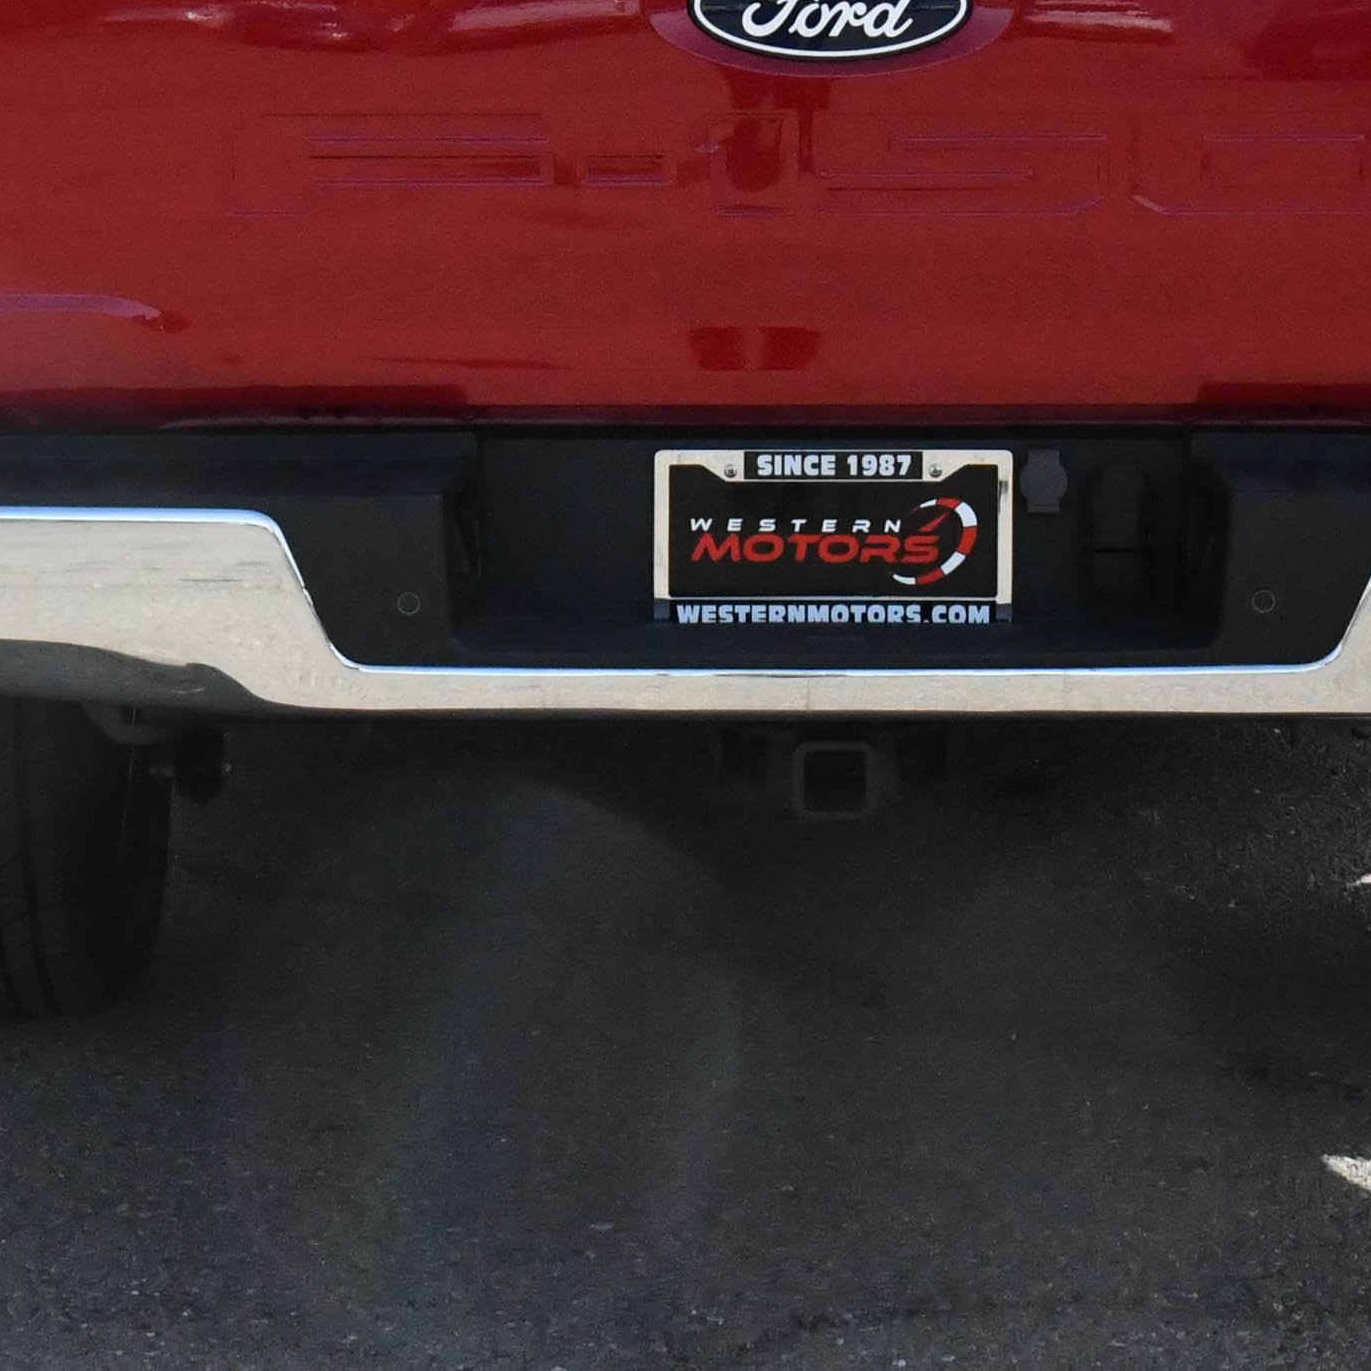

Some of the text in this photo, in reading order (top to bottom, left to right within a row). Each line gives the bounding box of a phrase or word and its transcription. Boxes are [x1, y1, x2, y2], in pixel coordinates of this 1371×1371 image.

[756, 454, 912, 477] SINCE 1987
[690, 518, 902, 533] WESTERN
[691, 532, 942, 563] MOTORS
[676, 604, 991, 625] WESTERNMOTORS.COM
